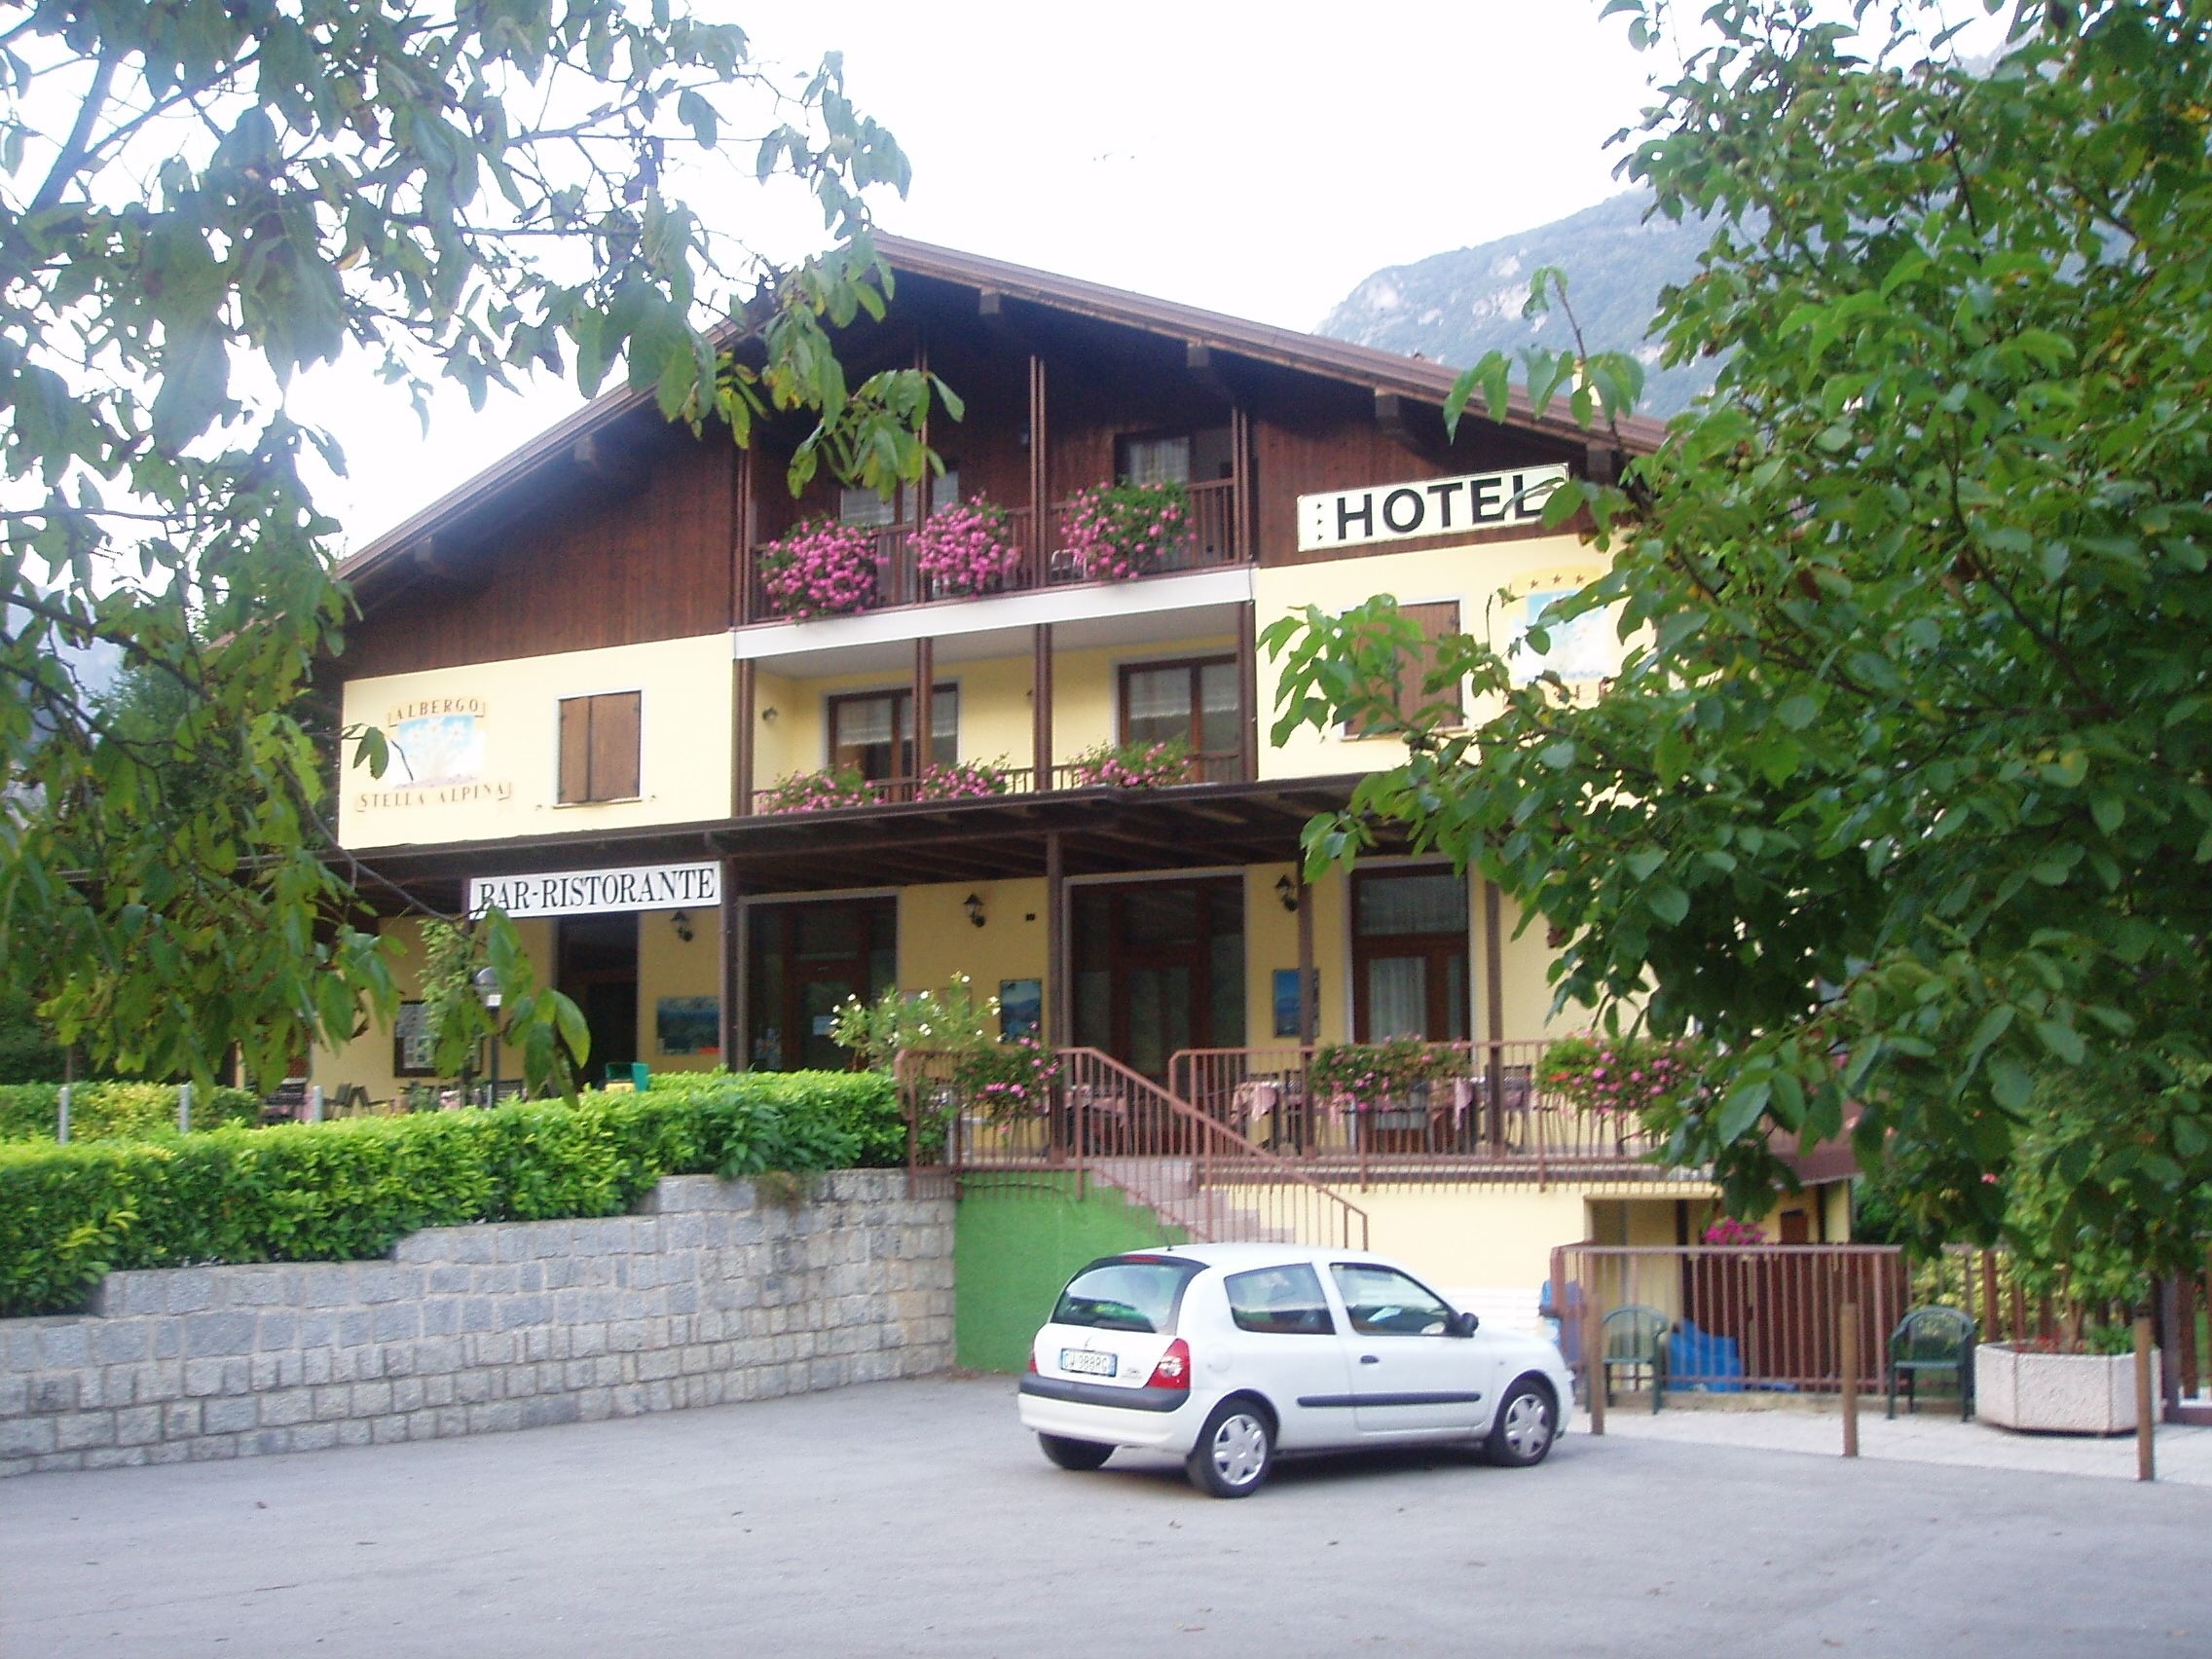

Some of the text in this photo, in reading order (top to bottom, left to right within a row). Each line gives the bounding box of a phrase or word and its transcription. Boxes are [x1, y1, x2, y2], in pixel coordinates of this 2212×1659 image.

[1337, 473, 1544, 540] HOTEL
[395, 698, 479, 719] ALBERGO
[359, 782, 504, 808] STELLA ALPINA
[479, 866, 716, 911] BAR-RISTORANTE
